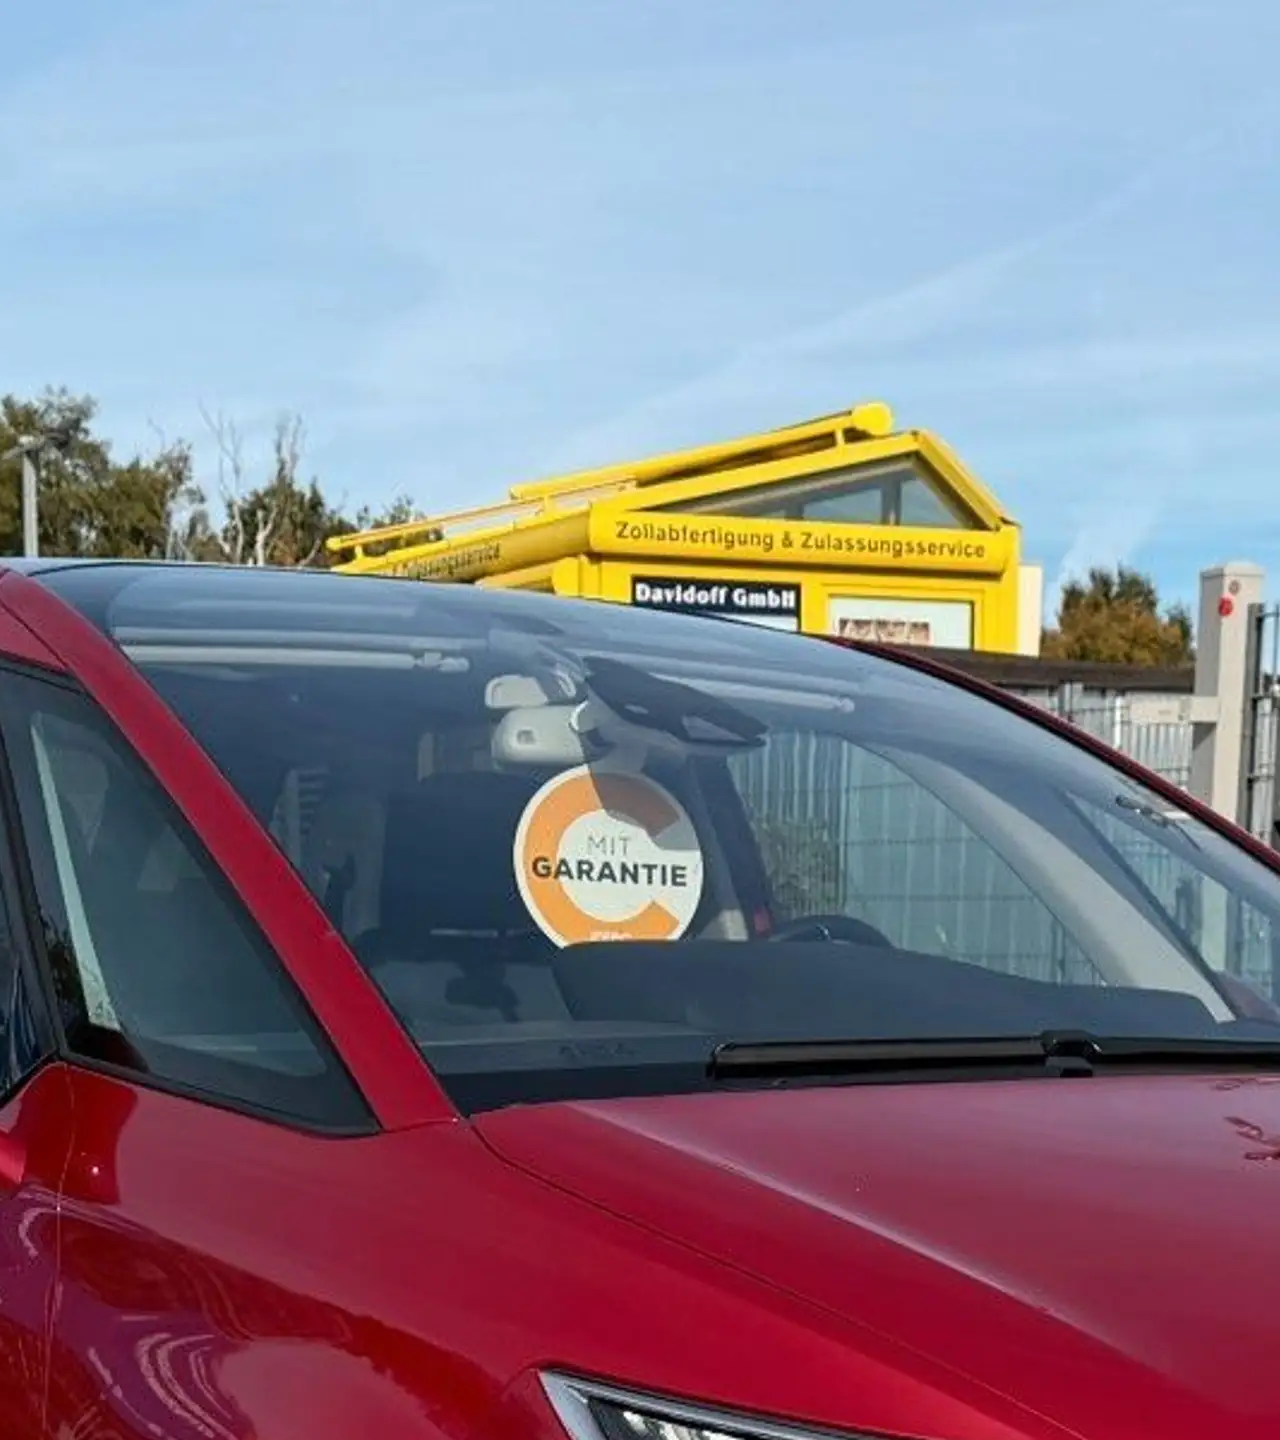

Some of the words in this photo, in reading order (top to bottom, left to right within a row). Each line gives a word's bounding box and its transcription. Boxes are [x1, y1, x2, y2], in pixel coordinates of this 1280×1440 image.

[616, 521, 774, 552] Zollabfertigung
[781, 531, 793, 548] &
[800, 531, 985, 558] Zulassungsservice
[634, 582, 729, 604] Davidoff
[732, 587, 796, 609] GmbH
[587, 835, 631, 857] MIT
[531, 856, 688, 887] GARANTIE
